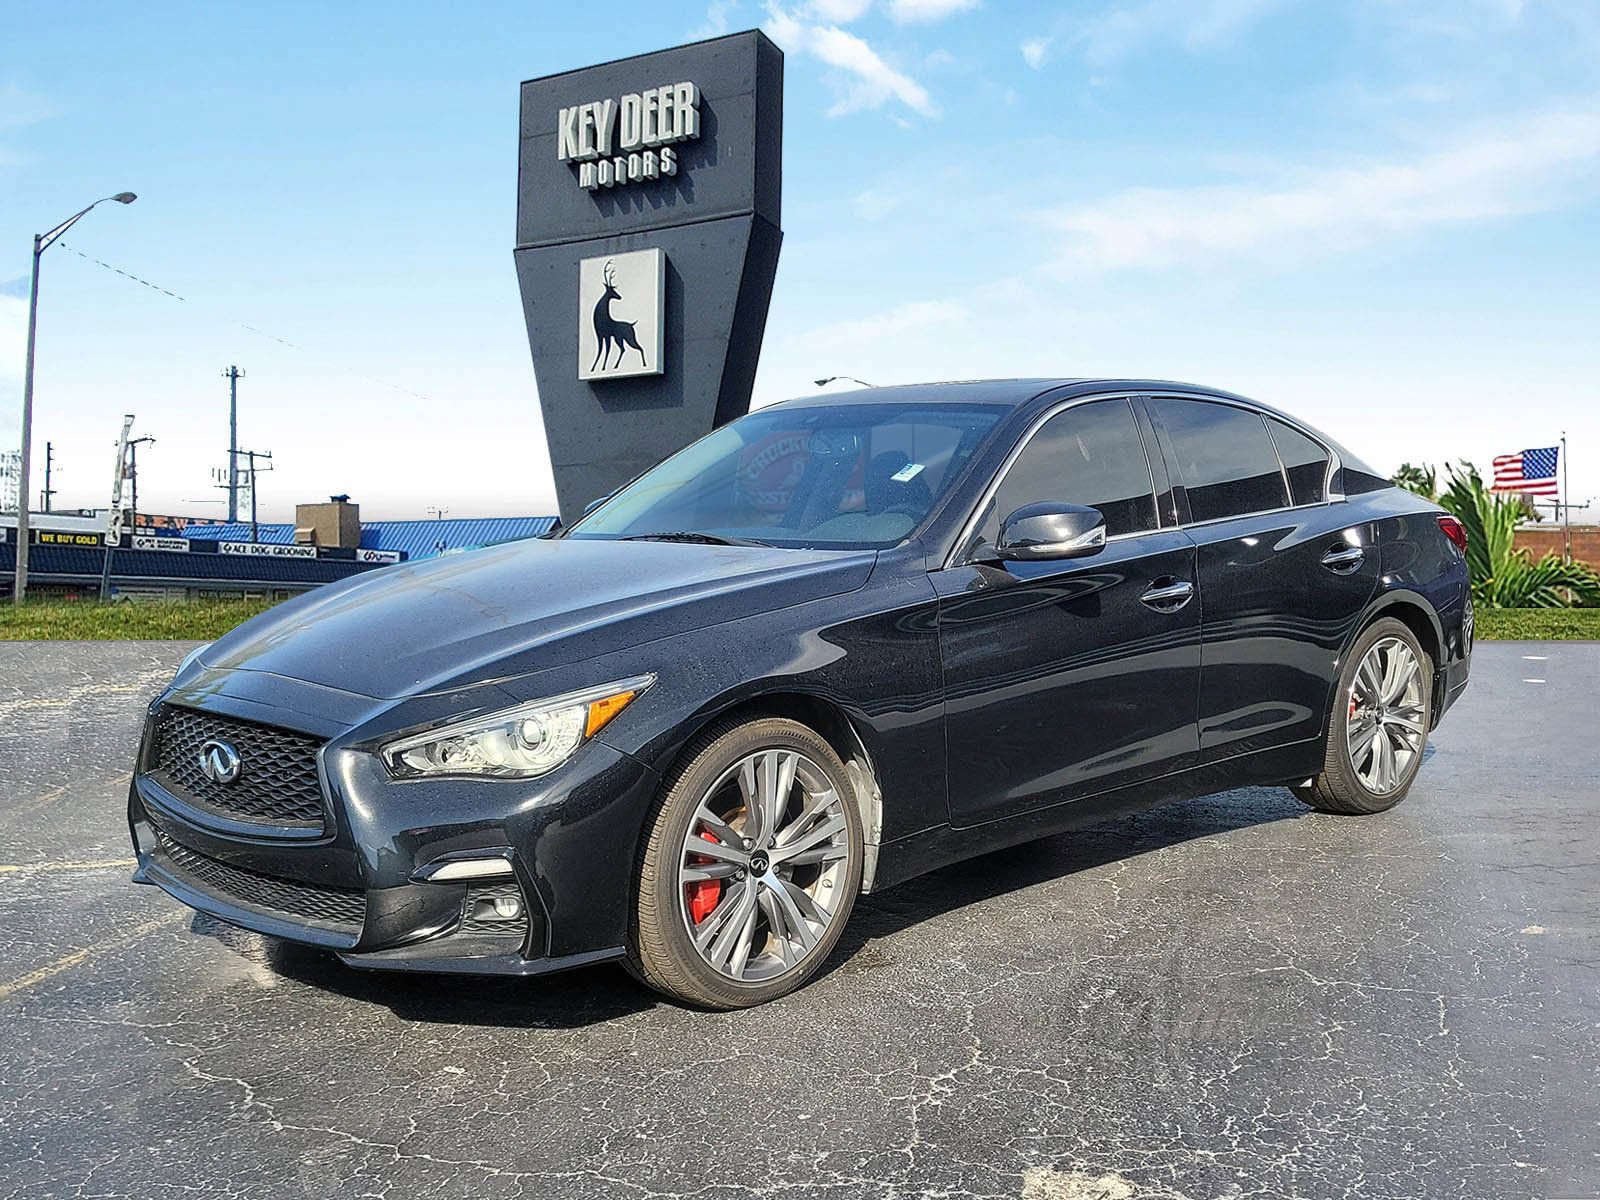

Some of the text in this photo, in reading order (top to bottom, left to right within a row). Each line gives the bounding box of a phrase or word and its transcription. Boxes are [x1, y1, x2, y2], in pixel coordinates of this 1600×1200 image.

[558, 81, 700, 161] KEY DEER
[579, 147, 677, 190] MOTORS
[41, 533, 97, 545] WE BUY GOLD
[232, 544, 315, 557] ACE DOG GROOMING
